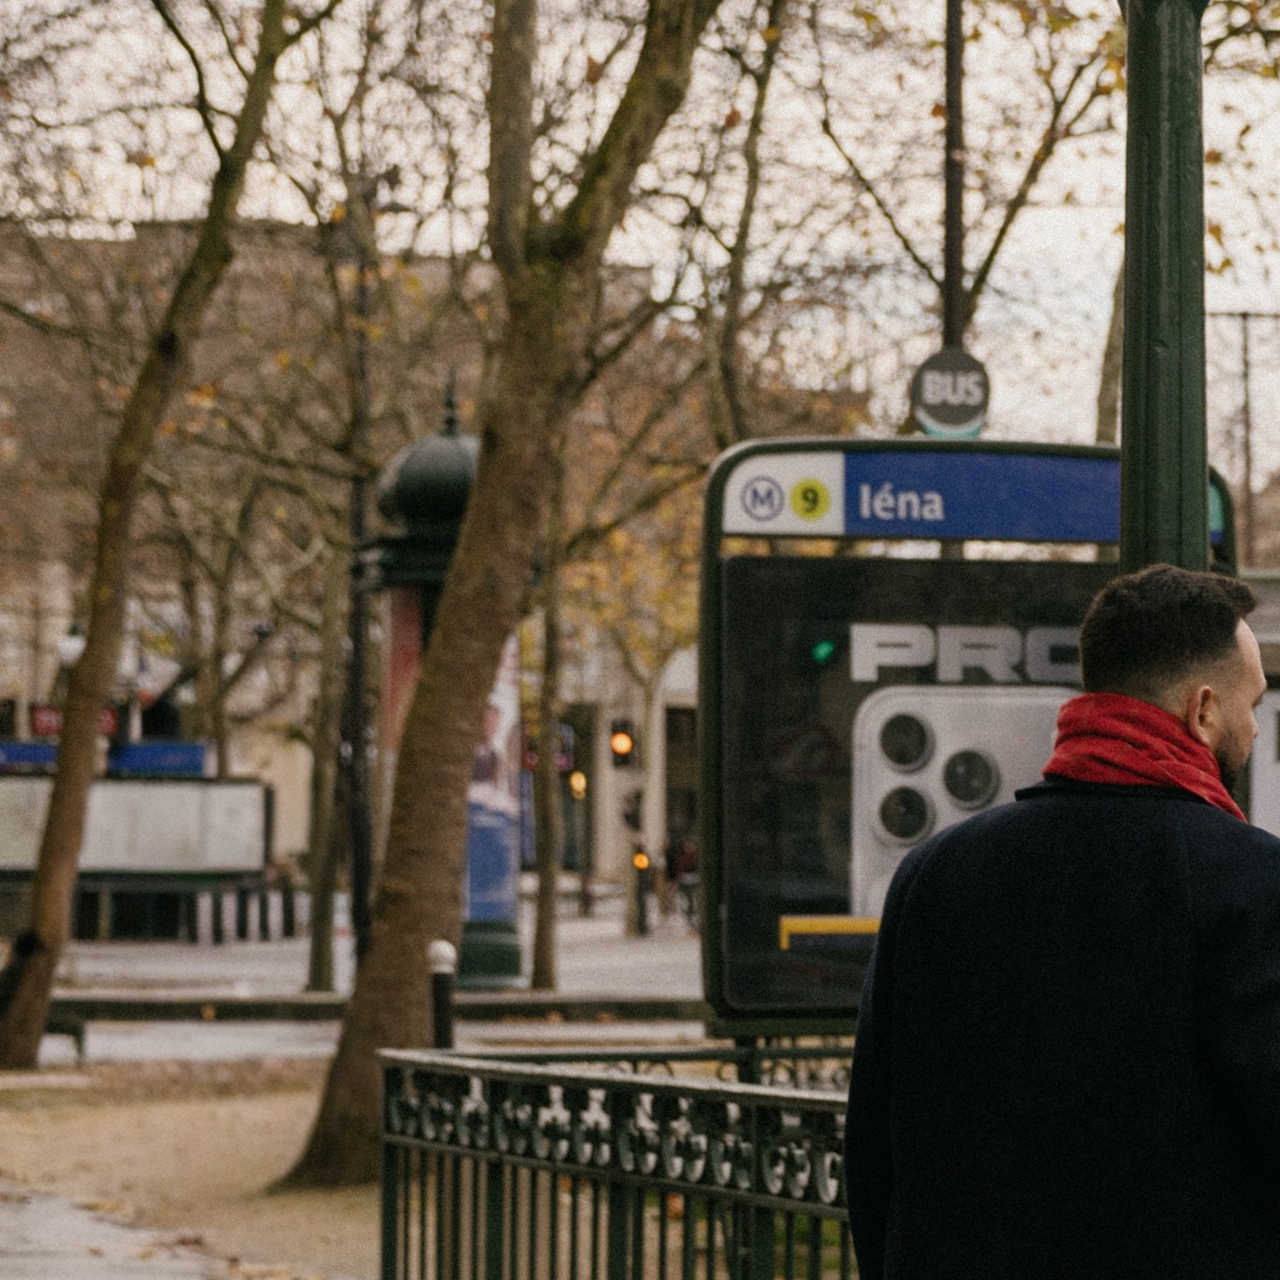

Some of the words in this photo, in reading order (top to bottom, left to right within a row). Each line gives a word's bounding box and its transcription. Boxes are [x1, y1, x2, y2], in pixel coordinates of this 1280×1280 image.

[922, 369, 984, 406] BUS
[750, 486, 774, 510] M
[801, 488, 819, 513] 9
[859, 481, 945, 520] Iéna
